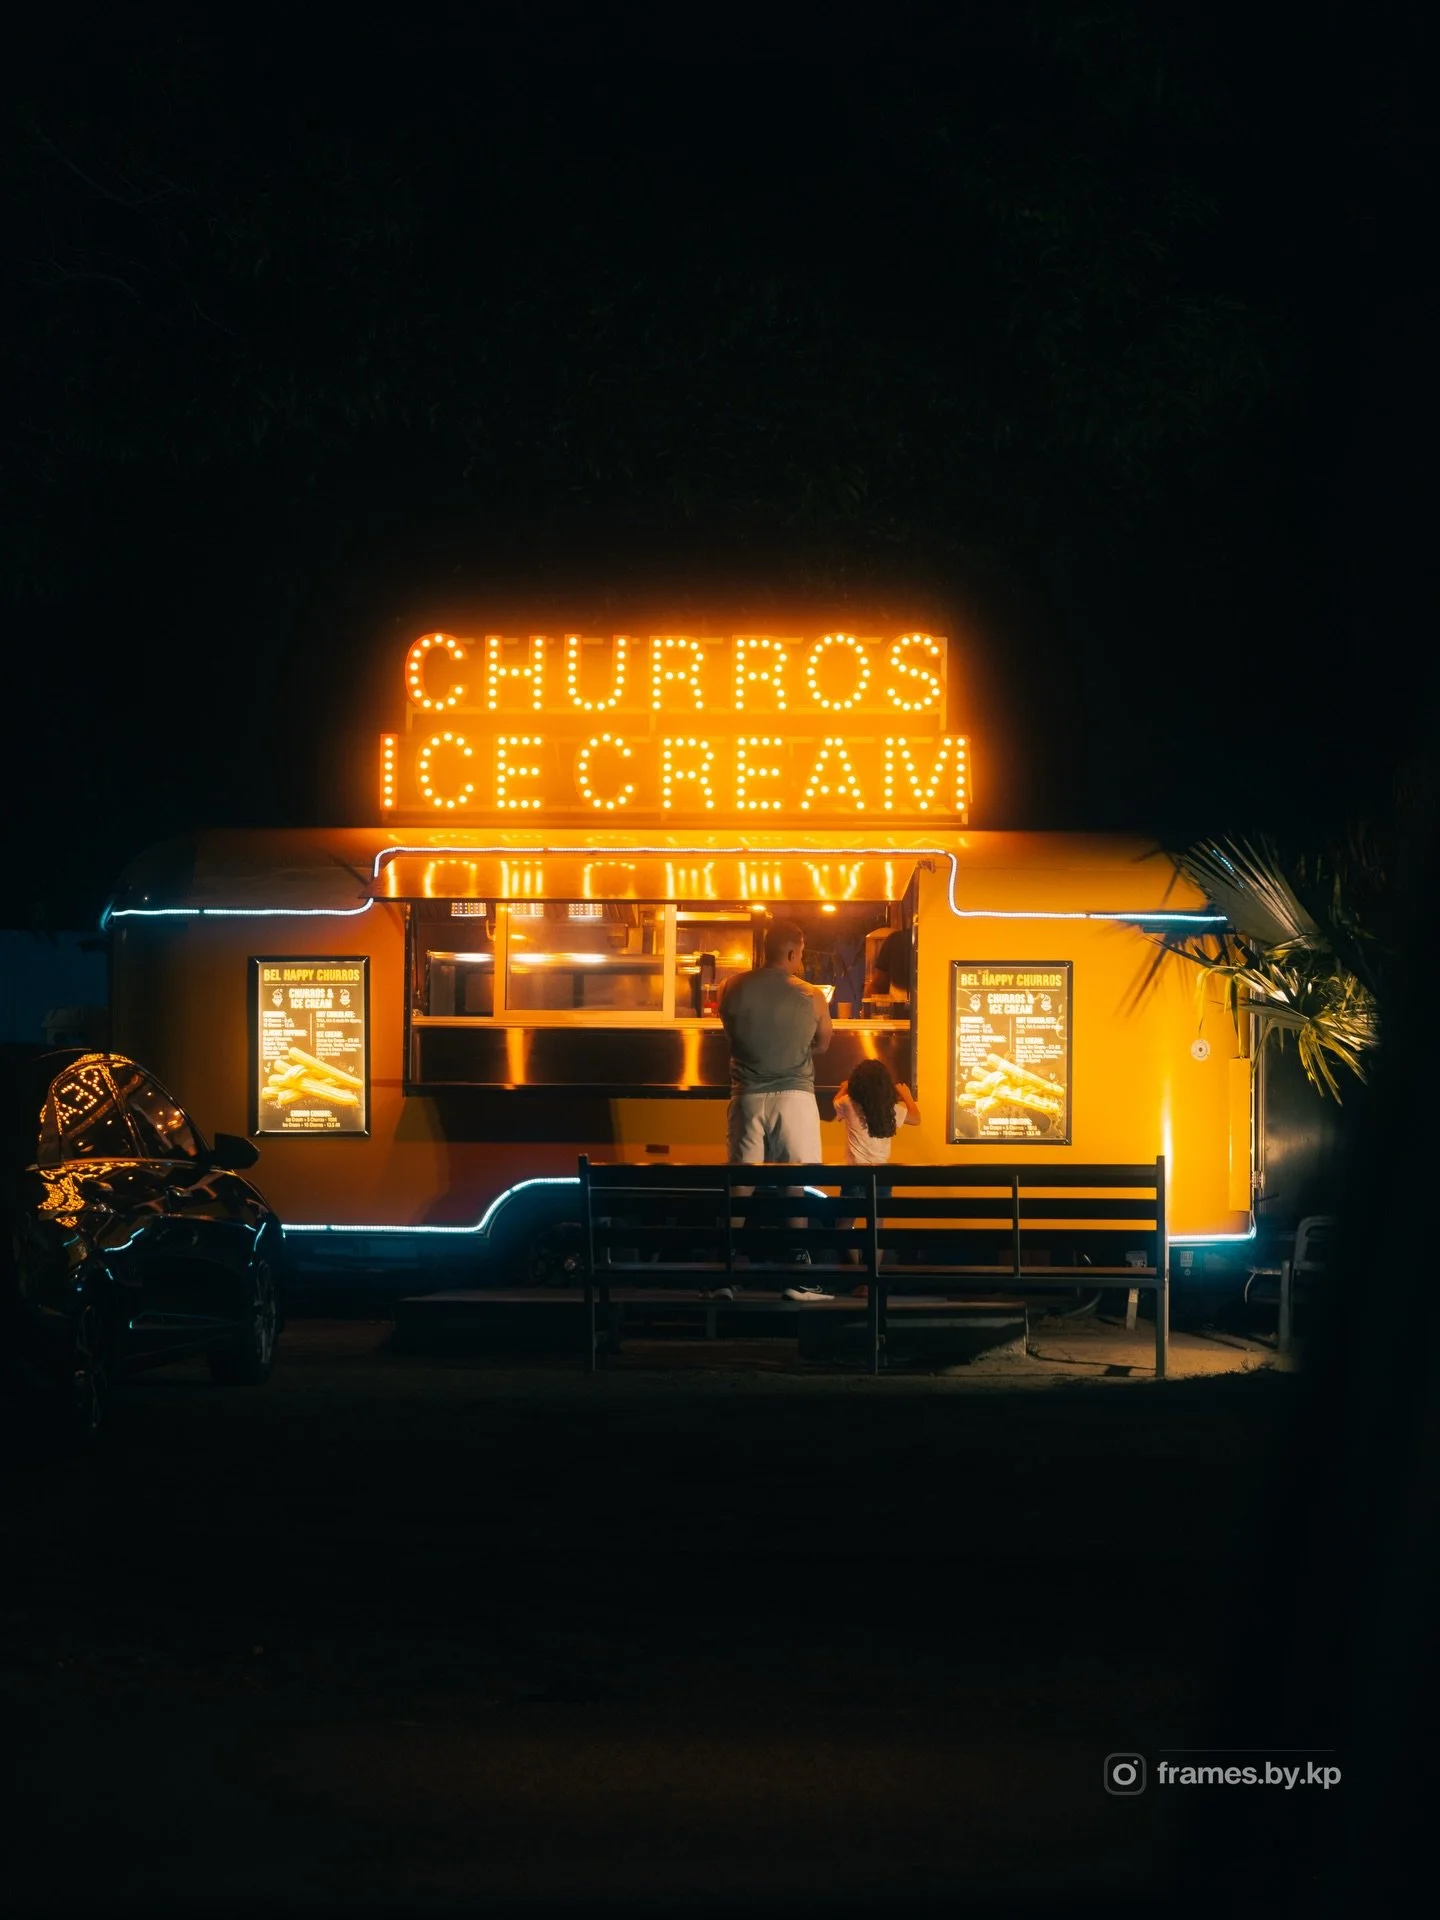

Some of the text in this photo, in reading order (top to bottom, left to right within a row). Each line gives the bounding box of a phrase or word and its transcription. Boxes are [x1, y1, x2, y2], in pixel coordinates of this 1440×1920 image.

[406, 632, 945, 710] CHURROS
[380, 732, 971, 811] ICE CREAM
[264, 969, 360, 981] BEL HAPPY CHURROS
[961, 974, 1062, 986] BEL HAPPY CHURROS
[289, 988, 334, 998] CHURROS &
[987, 994, 1026, 1003] CHURROS
[291, 999, 332, 1008] ICE CREAM
[989, 1004, 1033, 1014] ICE CREAM
